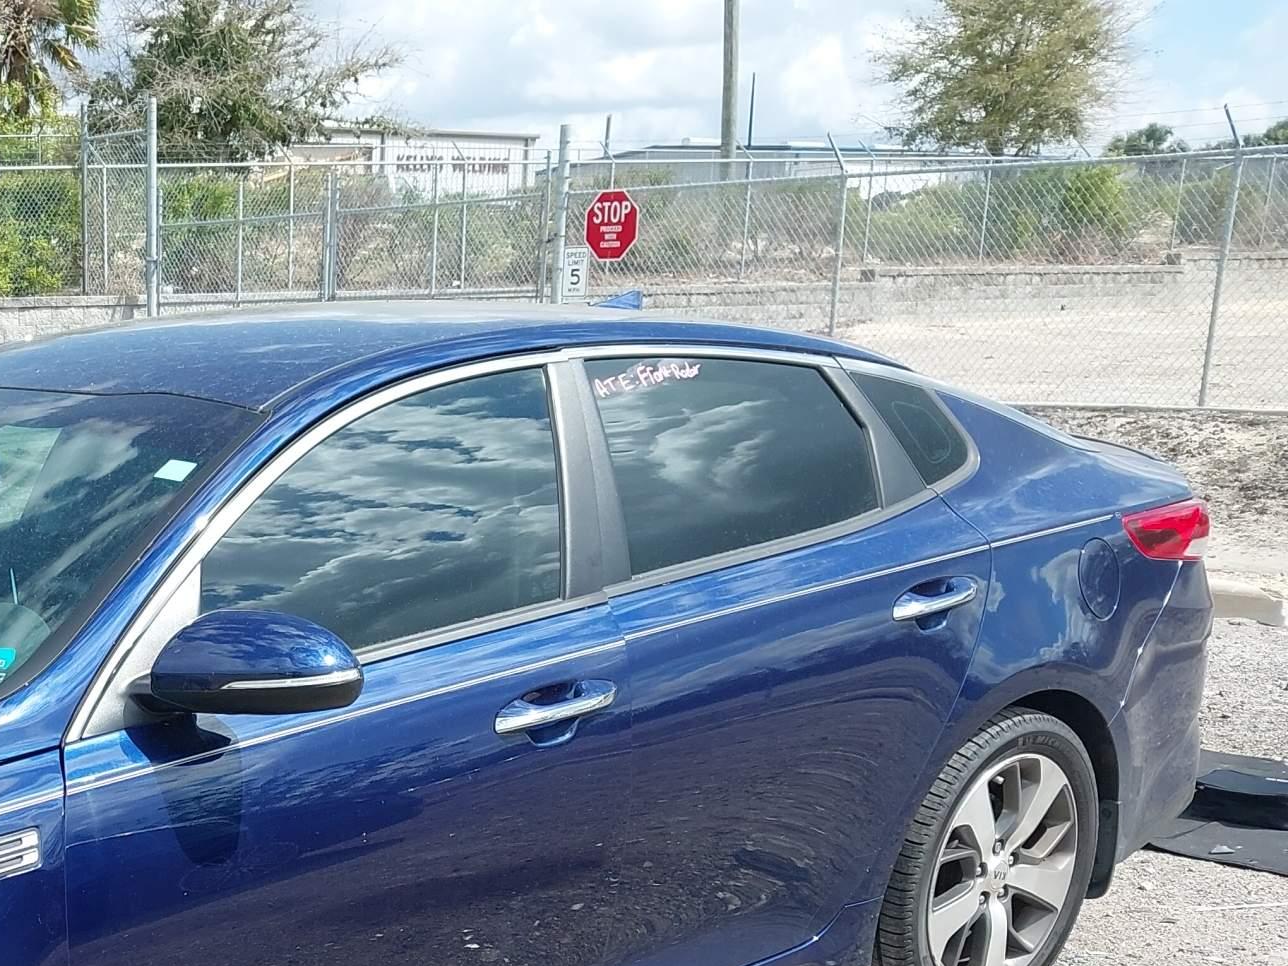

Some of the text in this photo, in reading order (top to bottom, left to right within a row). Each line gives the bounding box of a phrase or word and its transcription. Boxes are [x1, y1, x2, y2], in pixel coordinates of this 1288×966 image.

[593, 201, 631, 224] STOP
[570, 268, 580, 285] 5
[994, 871, 1006, 880] KIA
